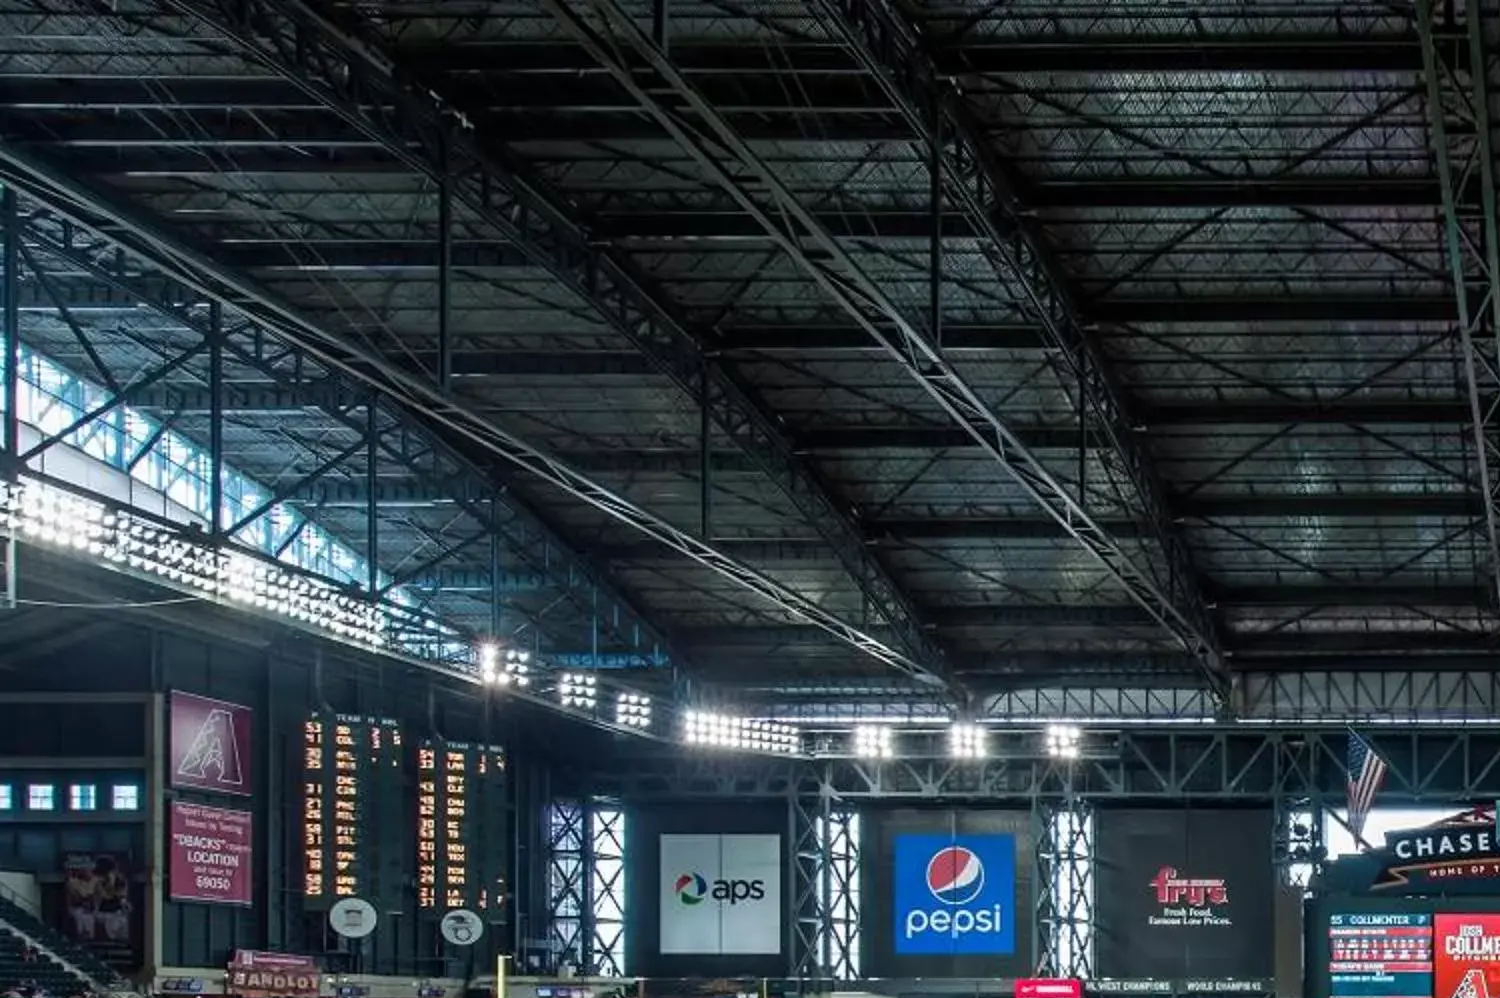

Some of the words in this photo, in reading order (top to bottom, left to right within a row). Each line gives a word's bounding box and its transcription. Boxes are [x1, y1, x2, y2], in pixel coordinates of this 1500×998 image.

[1395, 832, 1490, 859] CHASE
[187, 851, 239, 867] LOCATION
[1429, 866, 1464, 878] HOME
[1471, 865, 1485, 875] OF
[711, 877, 765, 903] aps
[905, 904, 1002, 940] pepsi
[1123, 982, 1170, 991] CHAMPIONS
[1187, 981, 1214, 991] WORLD
